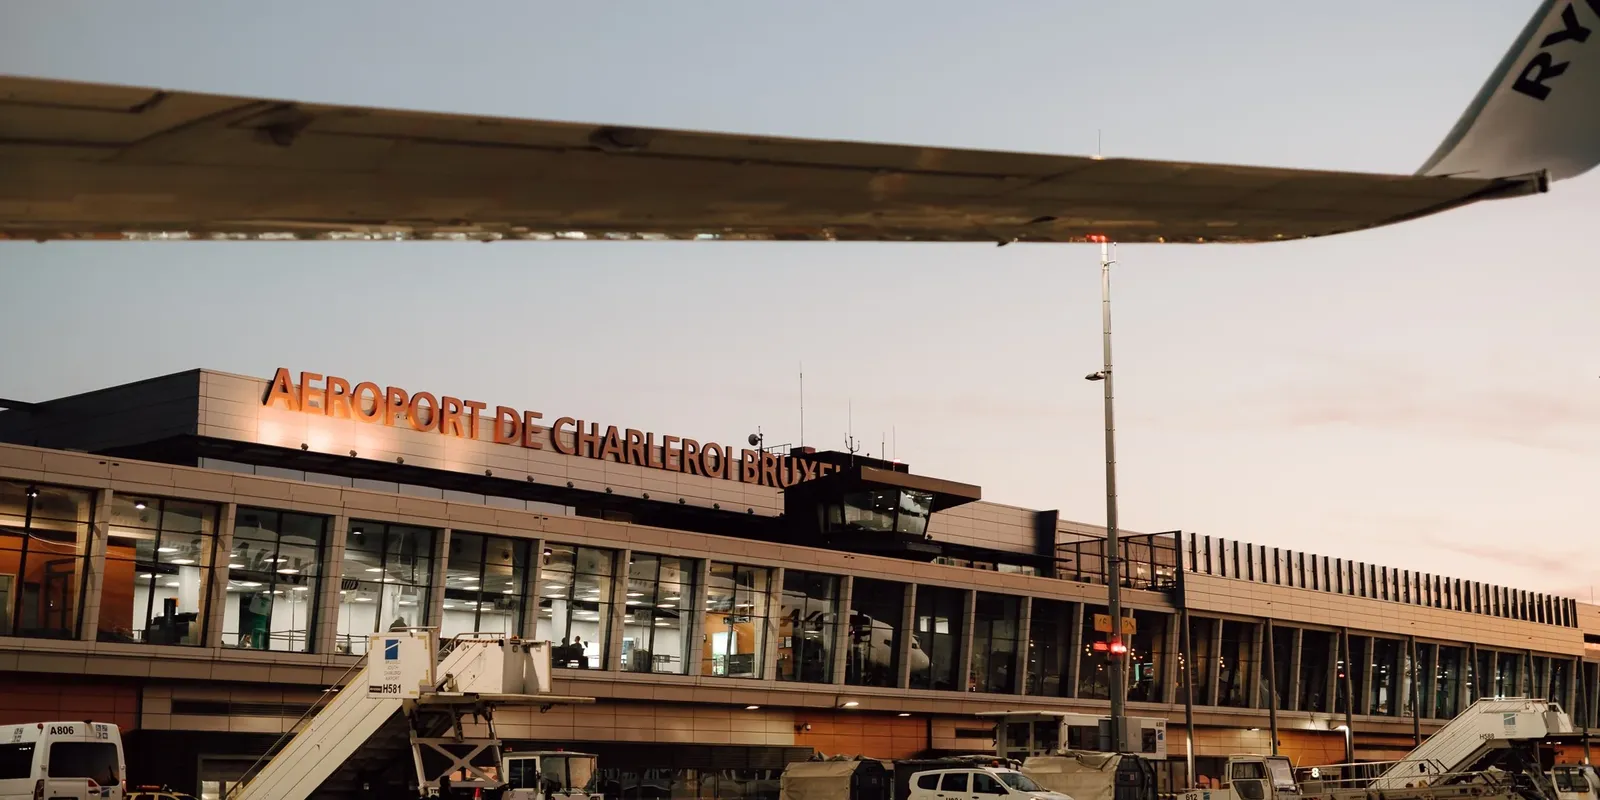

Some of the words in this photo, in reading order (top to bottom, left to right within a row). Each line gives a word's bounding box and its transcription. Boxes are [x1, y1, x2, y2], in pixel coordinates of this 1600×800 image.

[1512, 0, 1600, 102] RY
[261, 367, 487, 441] AEROPORT
[494, 405, 544, 450] DE
[550, 416, 733, 481] CHARLEROI
[741, 448, 841, 489] BRUX
[383, 684, 401, 694] H581
[50, 726, 74, 735] A806
